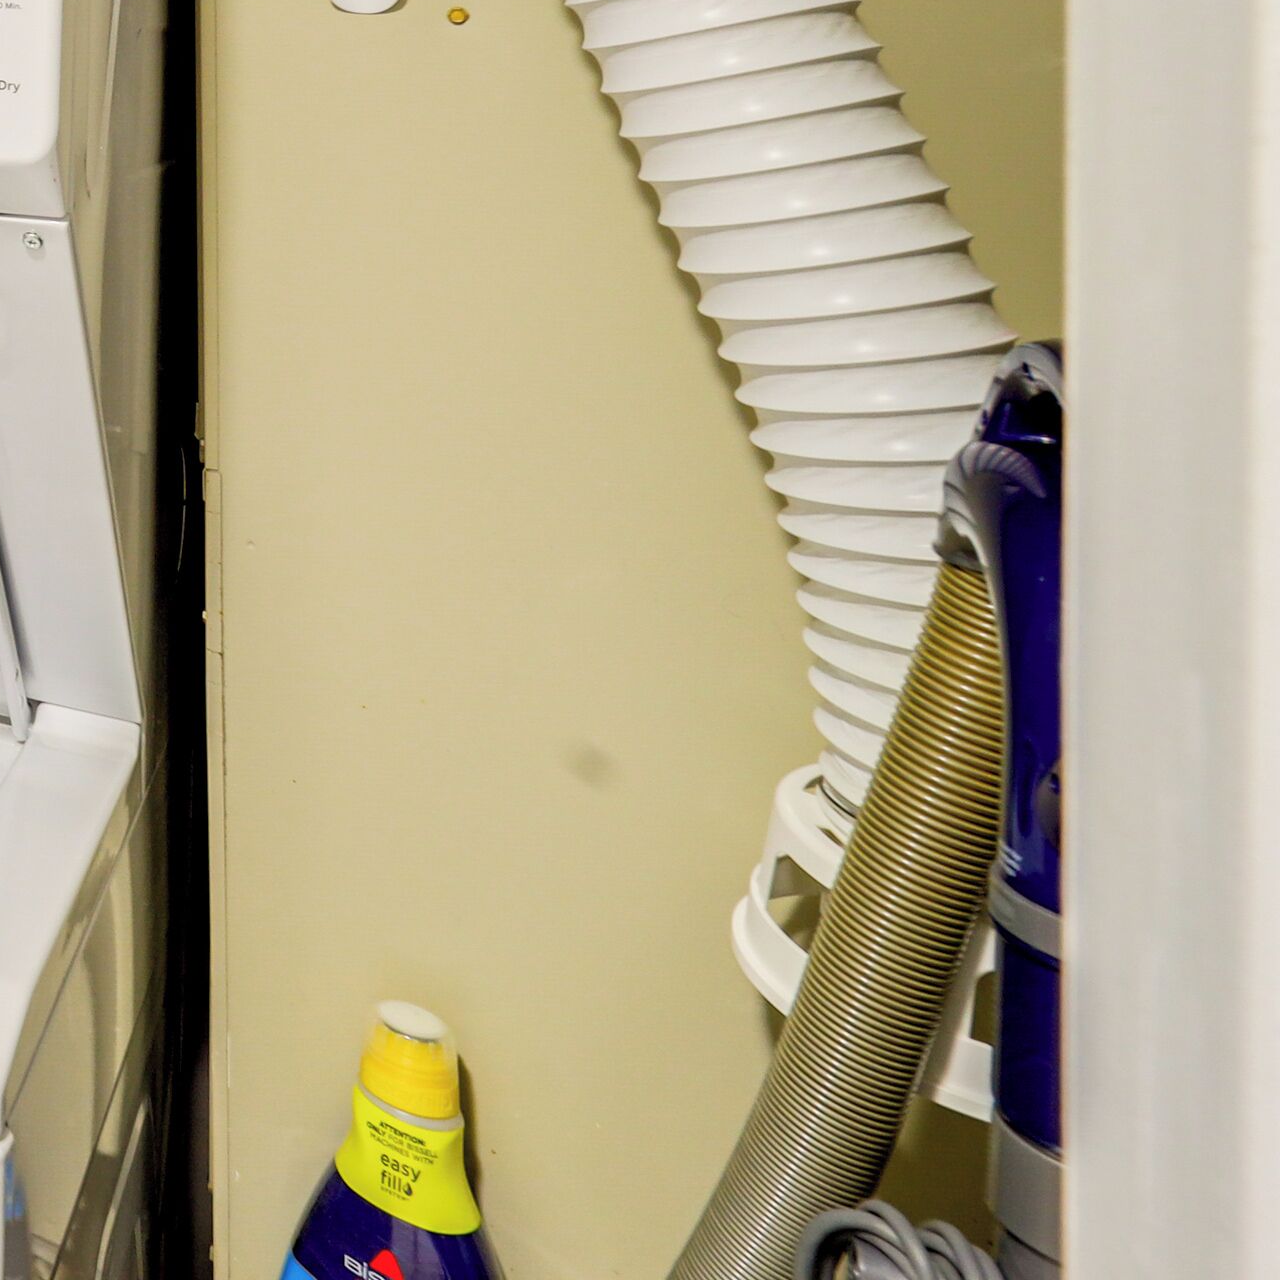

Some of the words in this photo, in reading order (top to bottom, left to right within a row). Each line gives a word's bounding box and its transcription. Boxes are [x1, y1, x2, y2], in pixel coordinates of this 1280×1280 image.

[366, 1121, 386, 1136] ONLY
[380, 1153, 421, 1183] easy
[381, 1169, 402, 1193] fill
